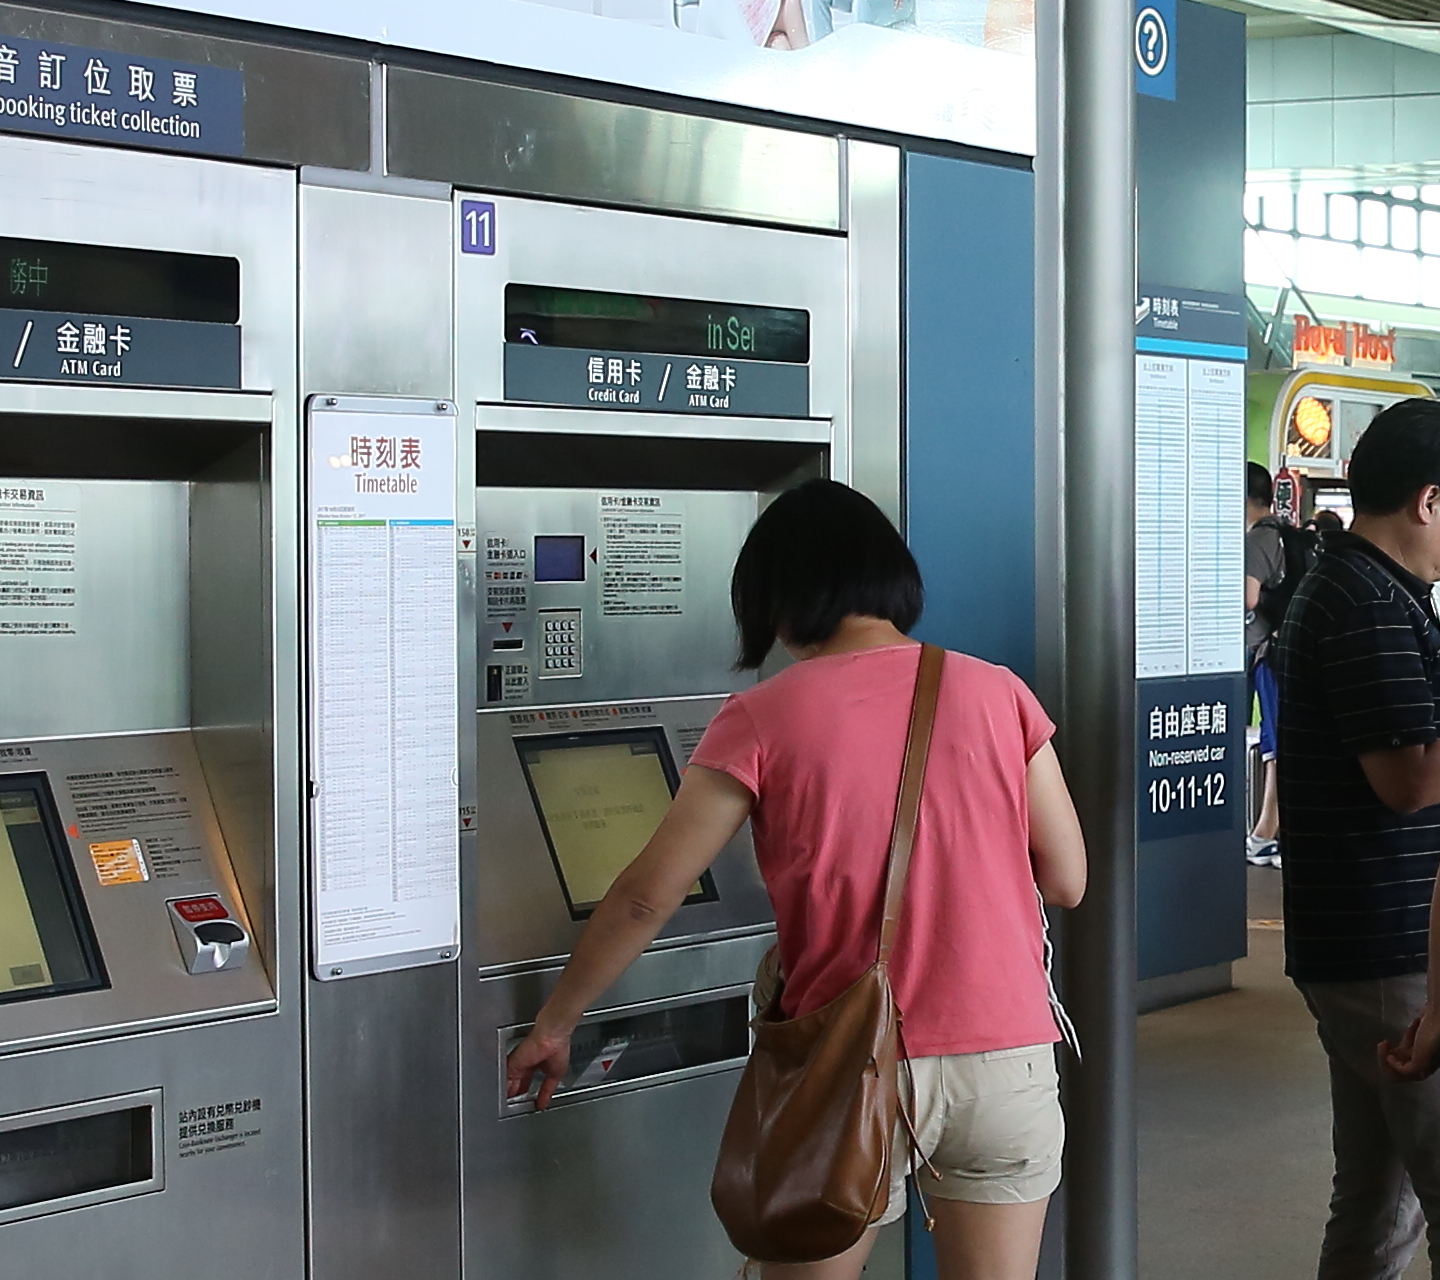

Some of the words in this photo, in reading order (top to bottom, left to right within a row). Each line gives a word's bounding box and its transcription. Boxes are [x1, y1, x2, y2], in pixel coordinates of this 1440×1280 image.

[69, 101, 117, 131] ticket
[120, 108, 201, 140] collection
[464, 210, 492, 249] 11
[1152, 297, 1180, 318] 時刻表
[56, 321, 132, 359] 金融卡
[707, 313, 723, 349] in
[1351, 321, 1397, 363] Host
[60, 358, 89, 377] ATM
[92, 360, 123, 379] Card
[587, 356, 643, 388] 信用卡
[686, 363, 737, 393] 金融卡
[587, 387, 616, 404] Credit
[618, 388, 640, 405] Card
[688, 394, 706, 408] ATM
[708, 394, 730, 410] Card
[350, 436, 421, 470] 時刻表
[354, 472, 418, 494] Timetable
[1149, 701, 1227, 741] 自由座車廂
[1149, 744, 1210, 768] Non-reserved
[1210, 746, 1226, 761] car
